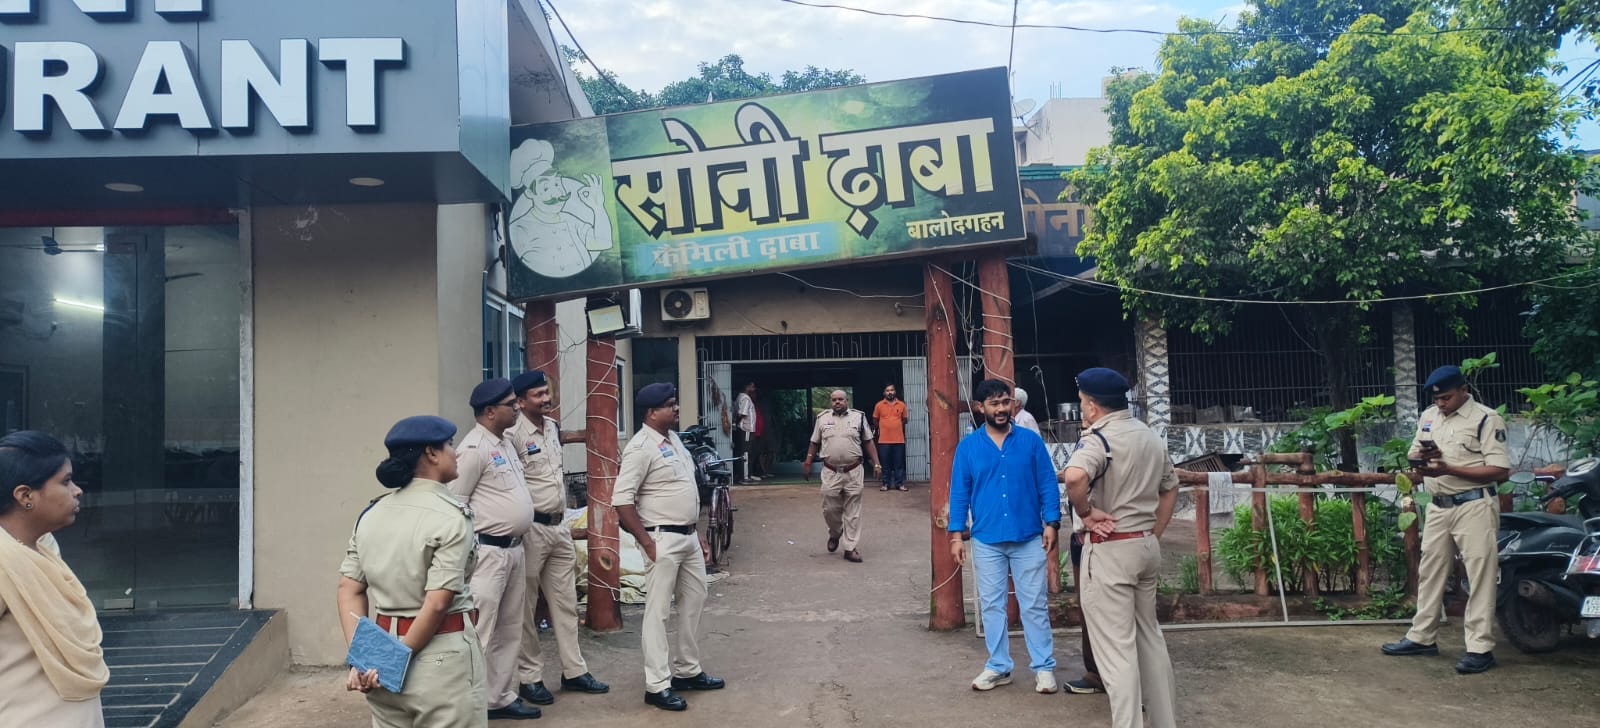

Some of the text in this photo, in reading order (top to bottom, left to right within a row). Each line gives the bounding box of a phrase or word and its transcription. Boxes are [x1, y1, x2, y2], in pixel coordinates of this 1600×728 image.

[0, 38, 404, 134] RANT
[611, 102, 995, 238] सोनी ढ़ाबा
[906, 209, 1005, 239] बालोदगहन
